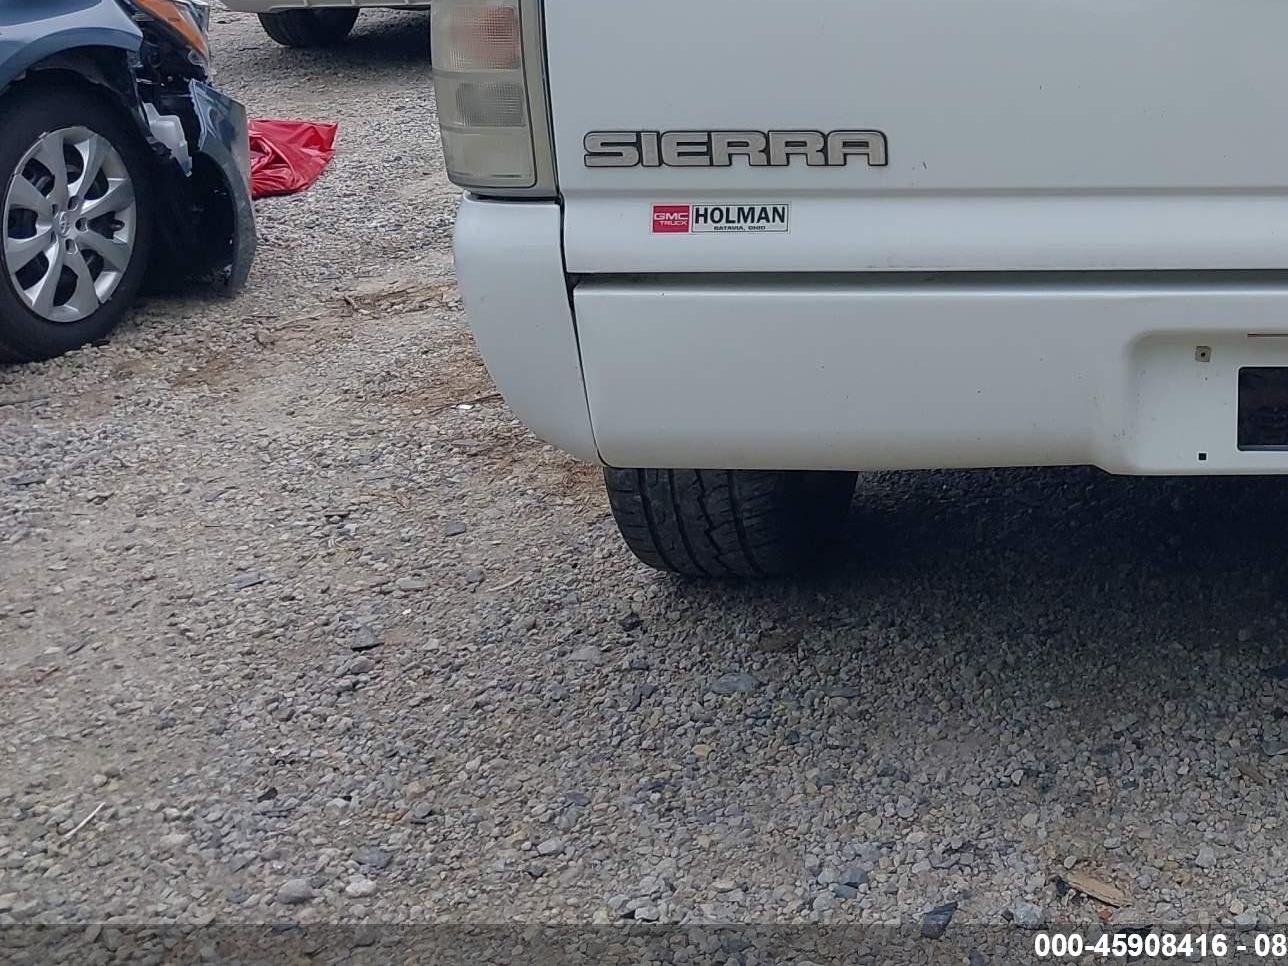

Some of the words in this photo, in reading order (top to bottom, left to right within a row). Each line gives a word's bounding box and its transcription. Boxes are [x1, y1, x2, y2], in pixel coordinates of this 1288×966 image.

[583, 130, 888, 168] SIERRA
[653, 212, 689, 221] GMC
[694, 206, 786, 225] HOLMAN
